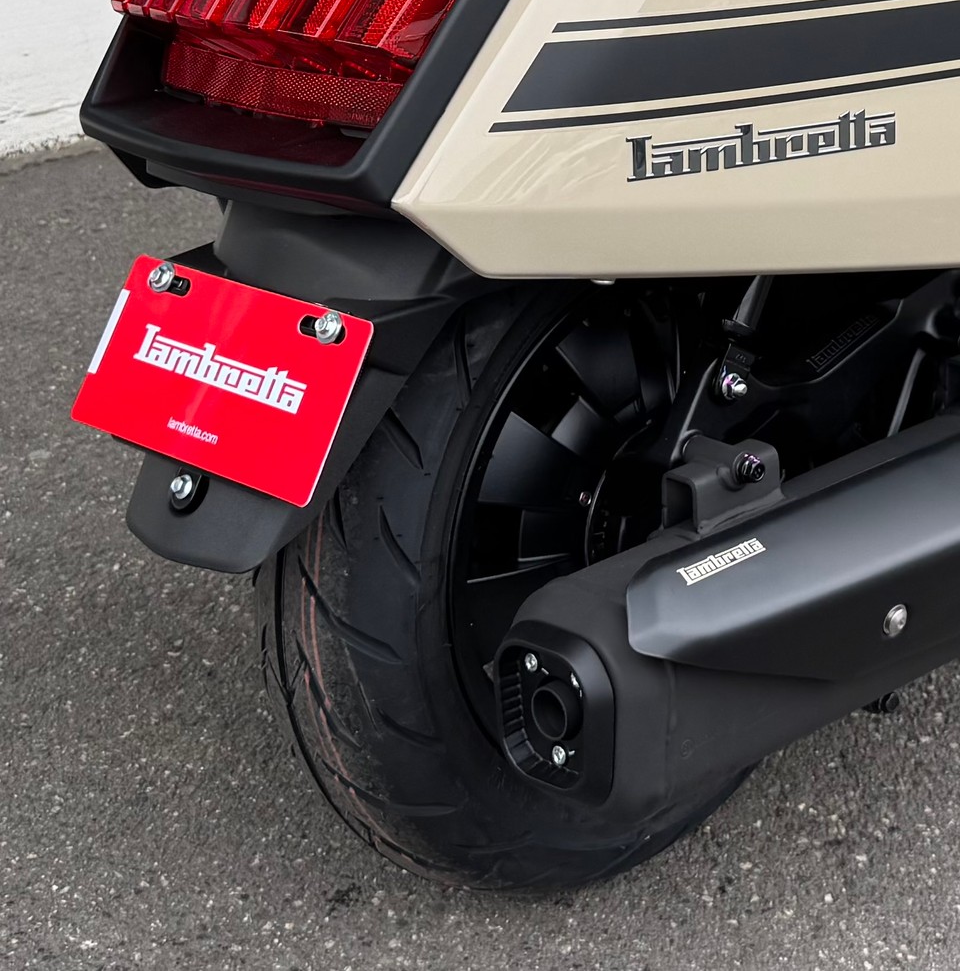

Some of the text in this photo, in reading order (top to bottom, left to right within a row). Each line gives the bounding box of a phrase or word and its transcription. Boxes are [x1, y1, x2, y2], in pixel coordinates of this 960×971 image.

[626, 109, 896, 182] Lambretta
[133, 323, 307, 415] Lambretta
[167, 417, 219, 445] lambretta.com
[676, 537, 767, 586] Lambretta
